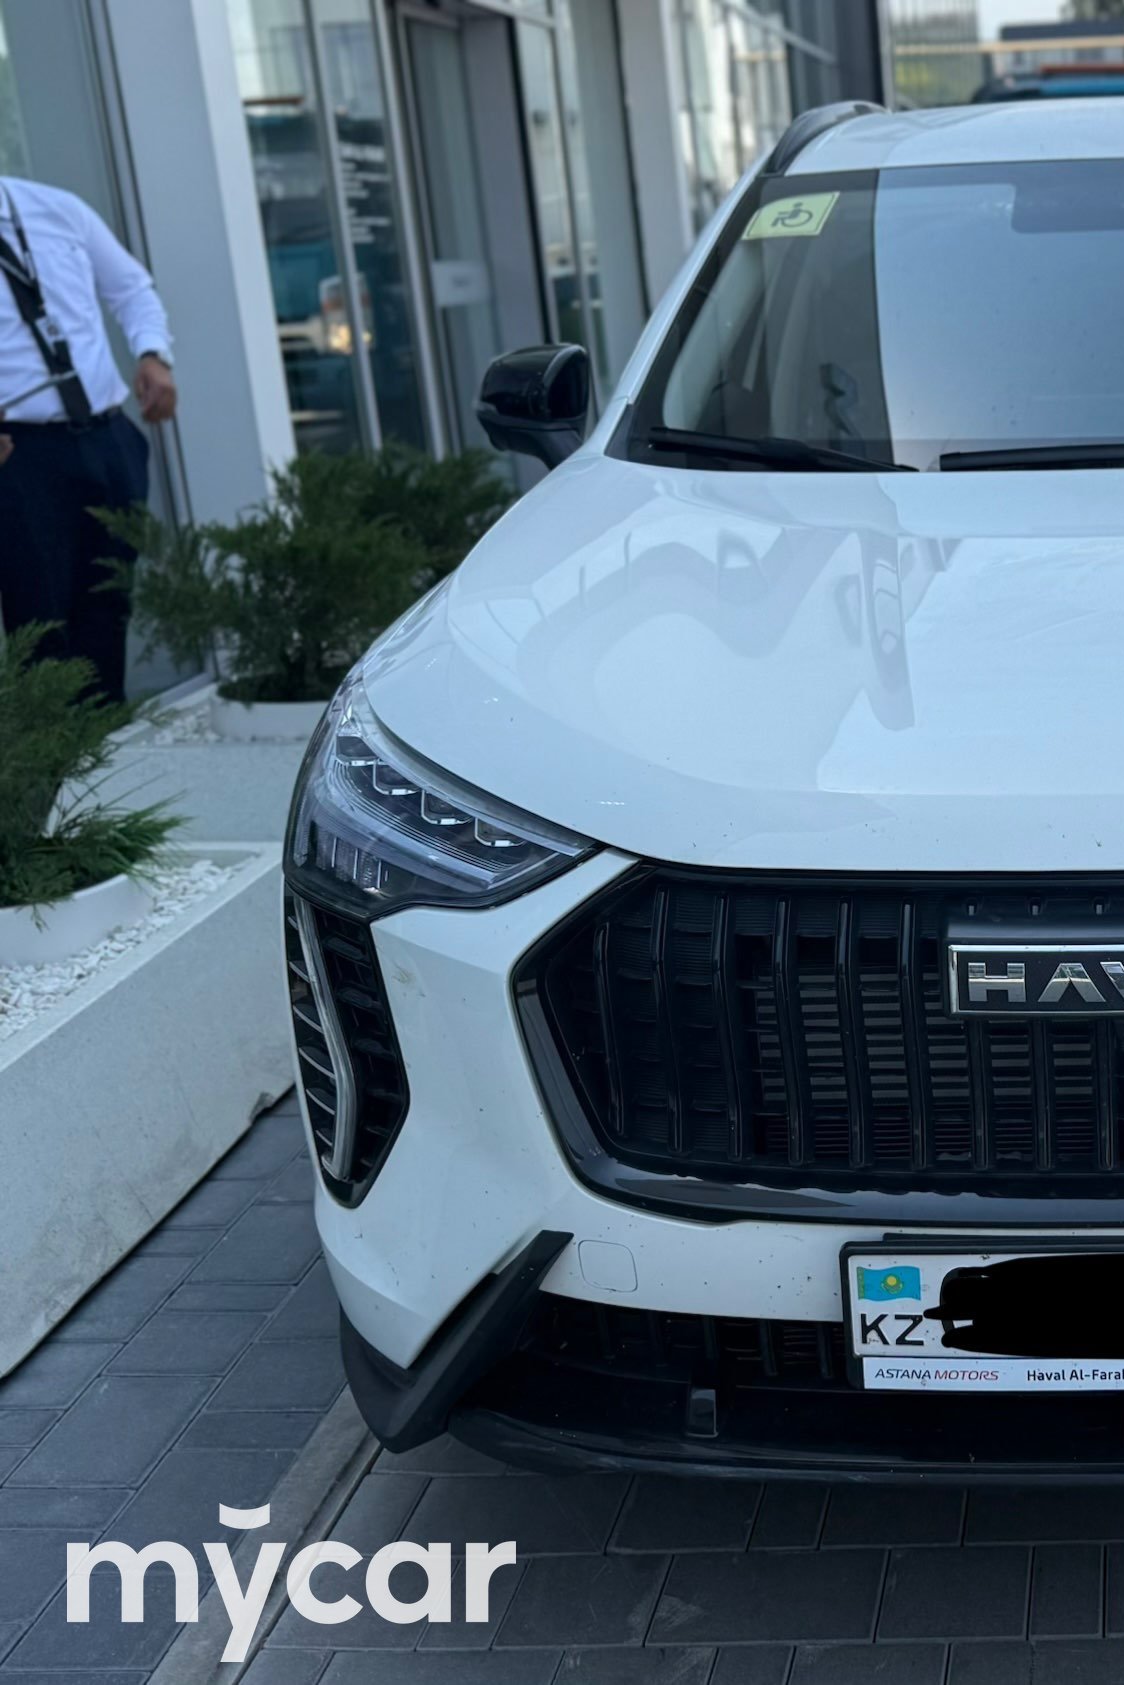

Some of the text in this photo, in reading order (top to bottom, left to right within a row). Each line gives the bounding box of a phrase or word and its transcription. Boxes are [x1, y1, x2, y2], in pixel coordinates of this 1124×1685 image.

[860, 1313, 924, 1346] KZ
[875, 1368, 999, 1381] ASTANA MOTORS
[1026, 1368, 1066, 1381] Haval
